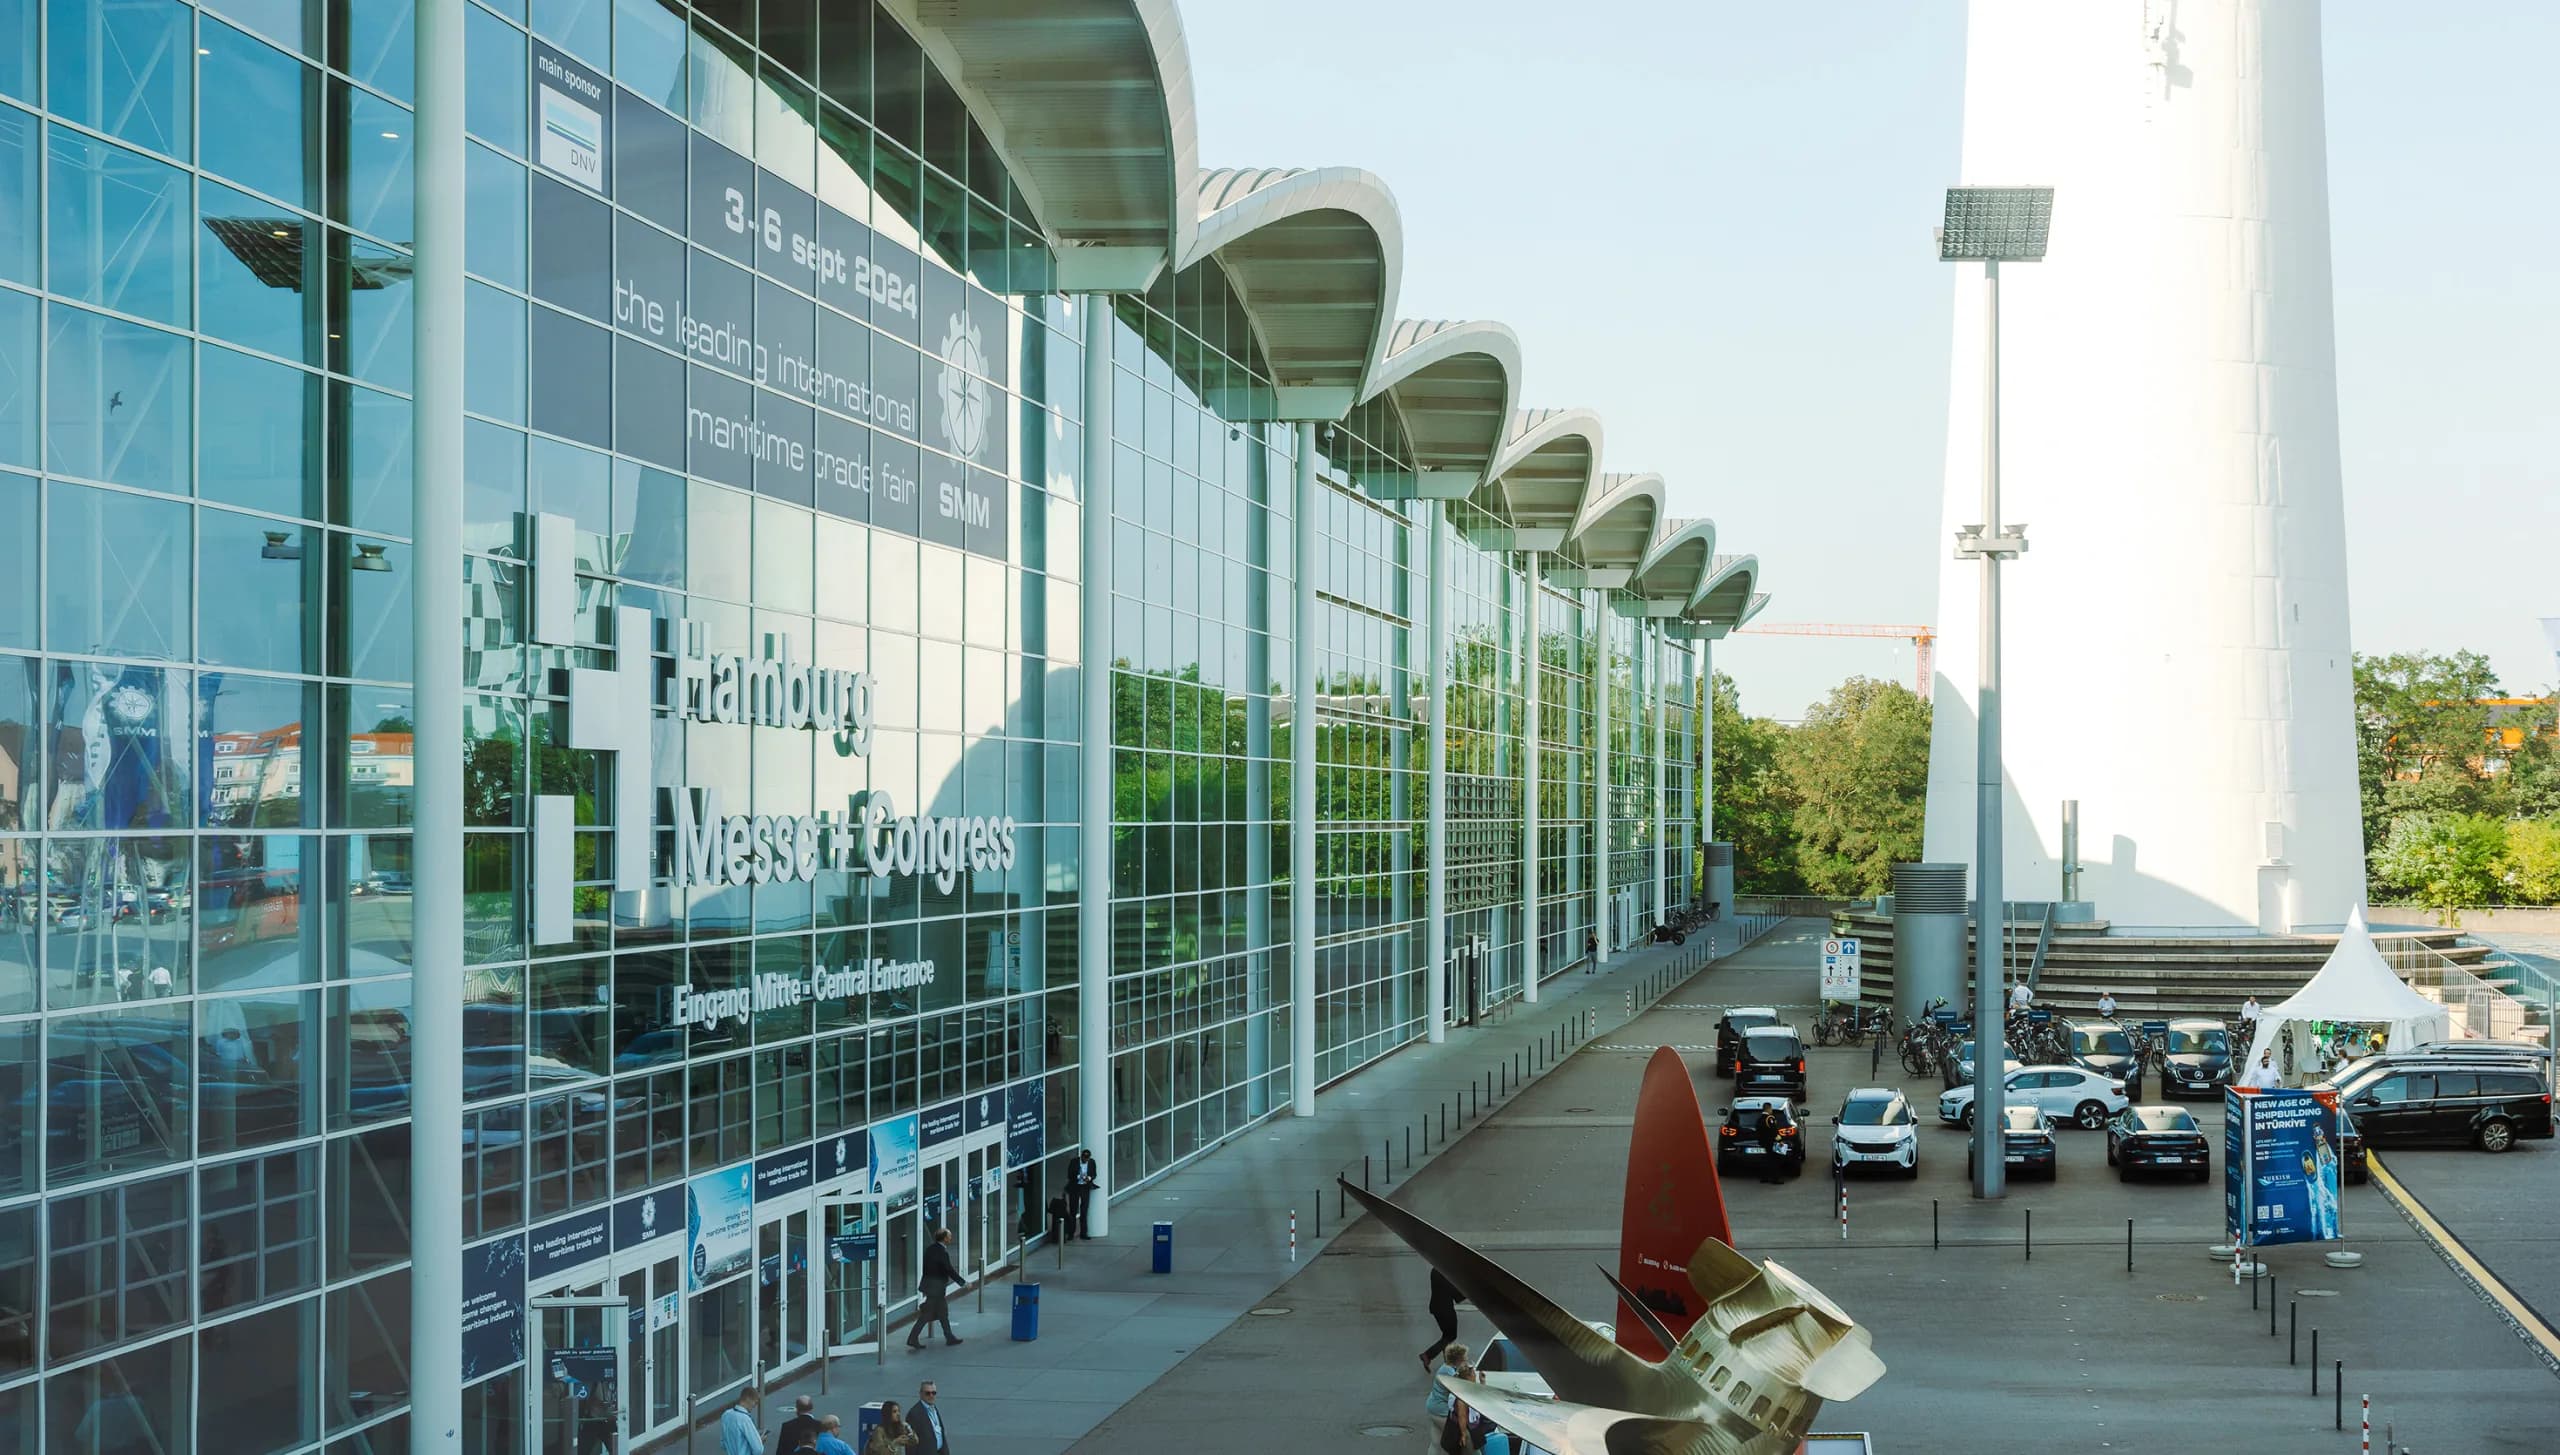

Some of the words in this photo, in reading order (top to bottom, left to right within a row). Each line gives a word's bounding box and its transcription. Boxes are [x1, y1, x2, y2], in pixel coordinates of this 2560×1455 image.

[538, 54, 563, 81] main
[564, 70, 601, 101] sponsor
[571, 148, 596, 174] DNV
[791, 231, 847, 287] sept
[854, 254, 918, 321] 2024
[615, 279, 665, 337] the
[675, 298, 769, 386] leading
[777, 342, 917, 435] international
[687, 403, 805, 474] maritime
[812, 447, 873, 496] trade
[881, 460, 917, 506] fair
[939, 481, 990, 530] SMM
[676, 617, 875, 757] Hamburg
[671, 786, 818, 889] Messe
[829, 810, 855, 872] +
[864, 790, 1016, 896] Congress
[673, 983, 751, 1031] Eingang
[752, 972, 801, 1012] Mitte
[811, 959, 870, 1001] Central
[871, 957, 935, 992] Entrance
[2254, 1100, 2278, 1109] NEW
[2299, 1098, 2313, 1106] OF
[2254, 1108, 2322, 1120] SHIPBUILDING
[2255, 1122, 2265, 1130] IN
[533, 1243, 545, 1253] the
[545, 1236, 567, 1249] leading
[567, 1223, 604, 1241] international
[548, 1244, 576, 1259] maritime
[576, 1238, 593, 1251] trade
[593, 1234, 604, 1244] fair
[641, 1228, 656, 1241] SMM
[471, 1291, 497, 1305] welcome
[480, 1299, 507, 1314] changers
[489, 1309, 514, 1324] industry
